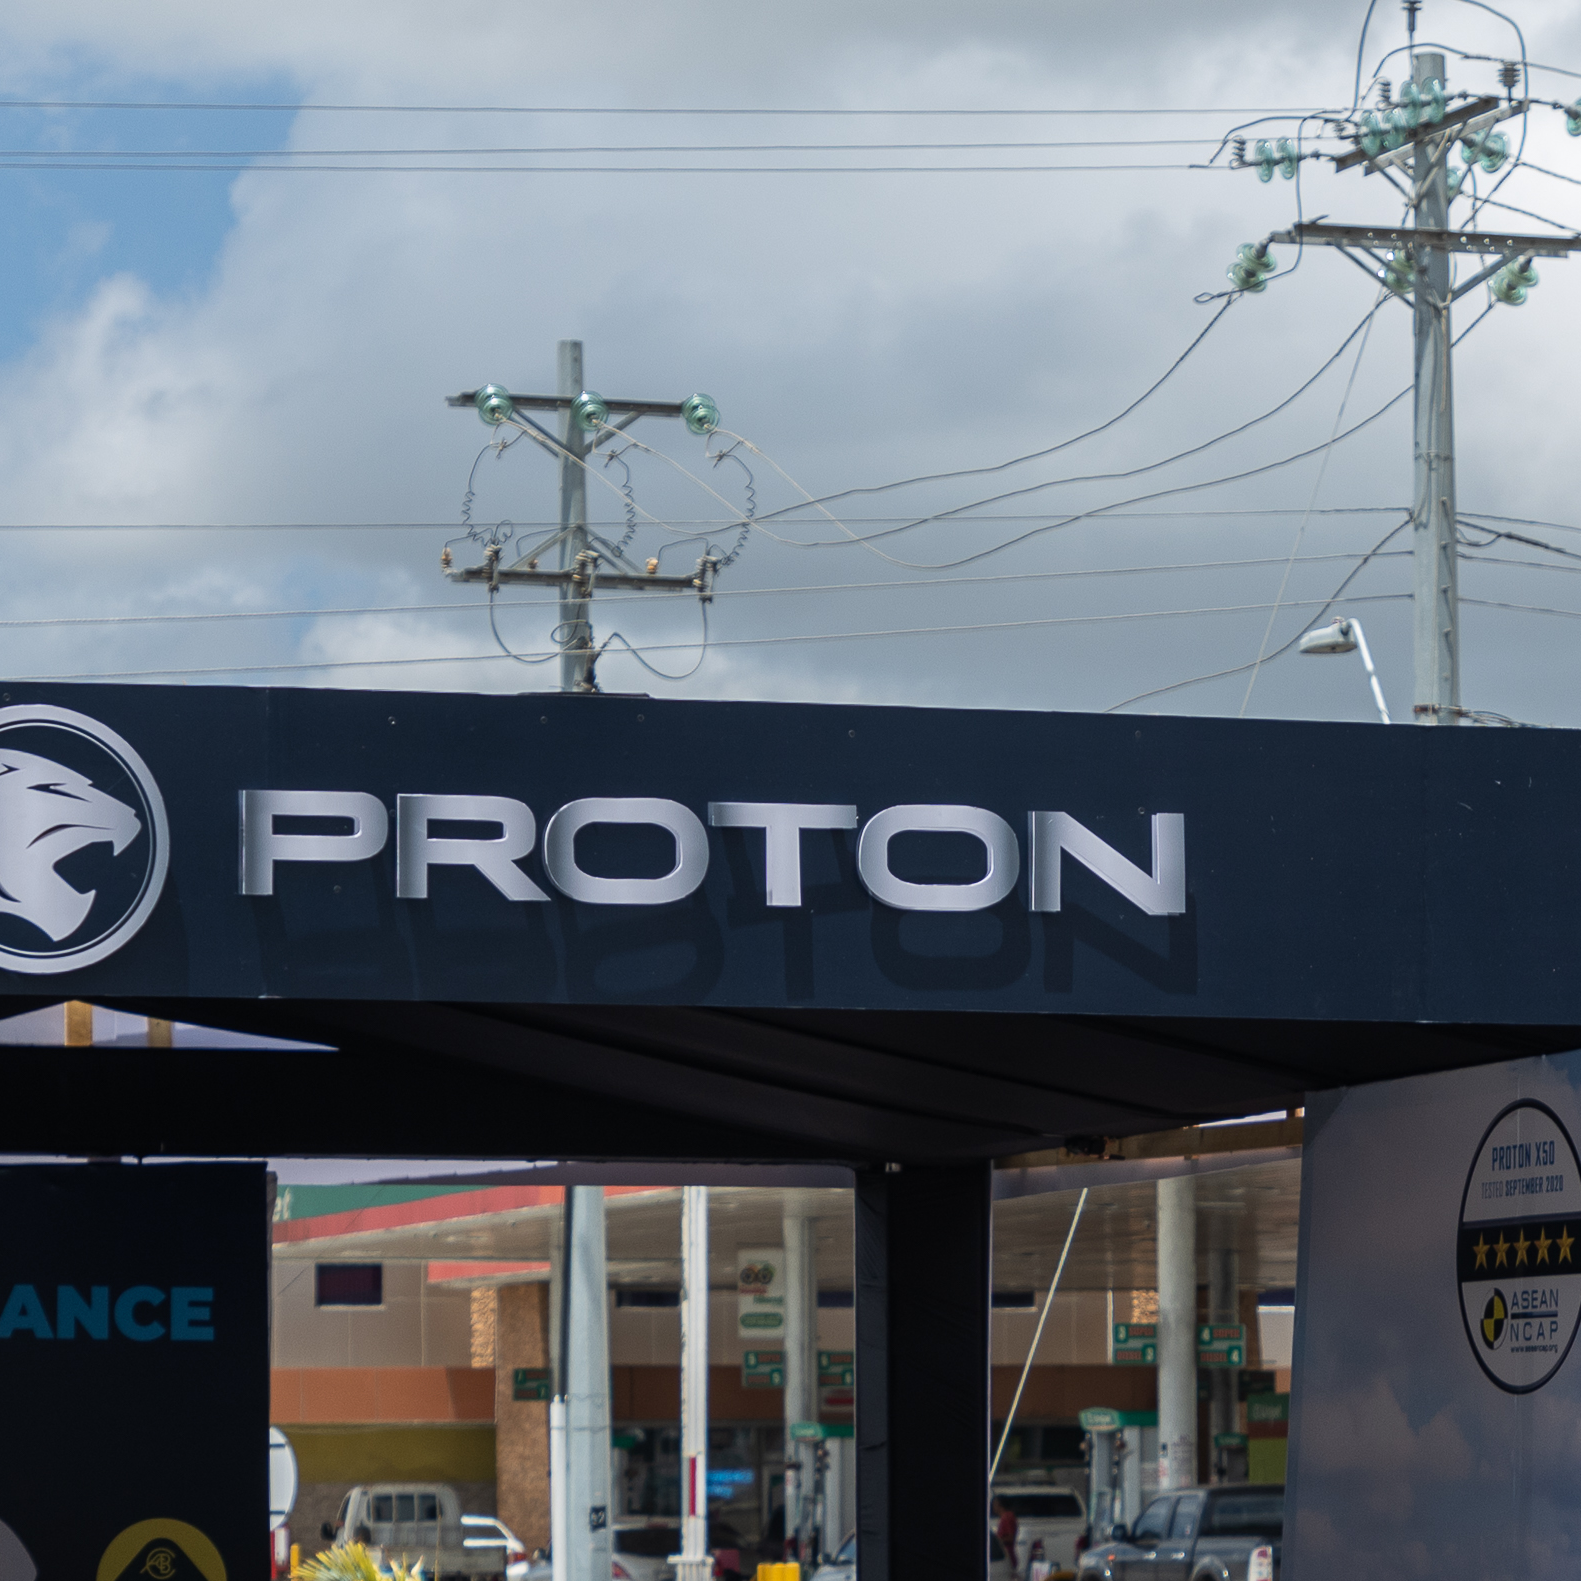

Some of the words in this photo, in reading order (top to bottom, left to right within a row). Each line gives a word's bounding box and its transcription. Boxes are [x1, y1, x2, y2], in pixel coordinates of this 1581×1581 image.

[238, 788, 1186, 915] PROTON
[1491, 1143, 1531, 1172] PROTON
[1535, 1140, 1555, 1167] X50
[1481, 1181, 1503, 1200] TESTED
[1505, 1176, 1544, 1198] SEPTEMBER
[1546, 1175, 1564, 1193] 2020
[1510, 1288, 1559, 1310] ASEAN
[1509, 1321, 1559, 1342] NCAP
